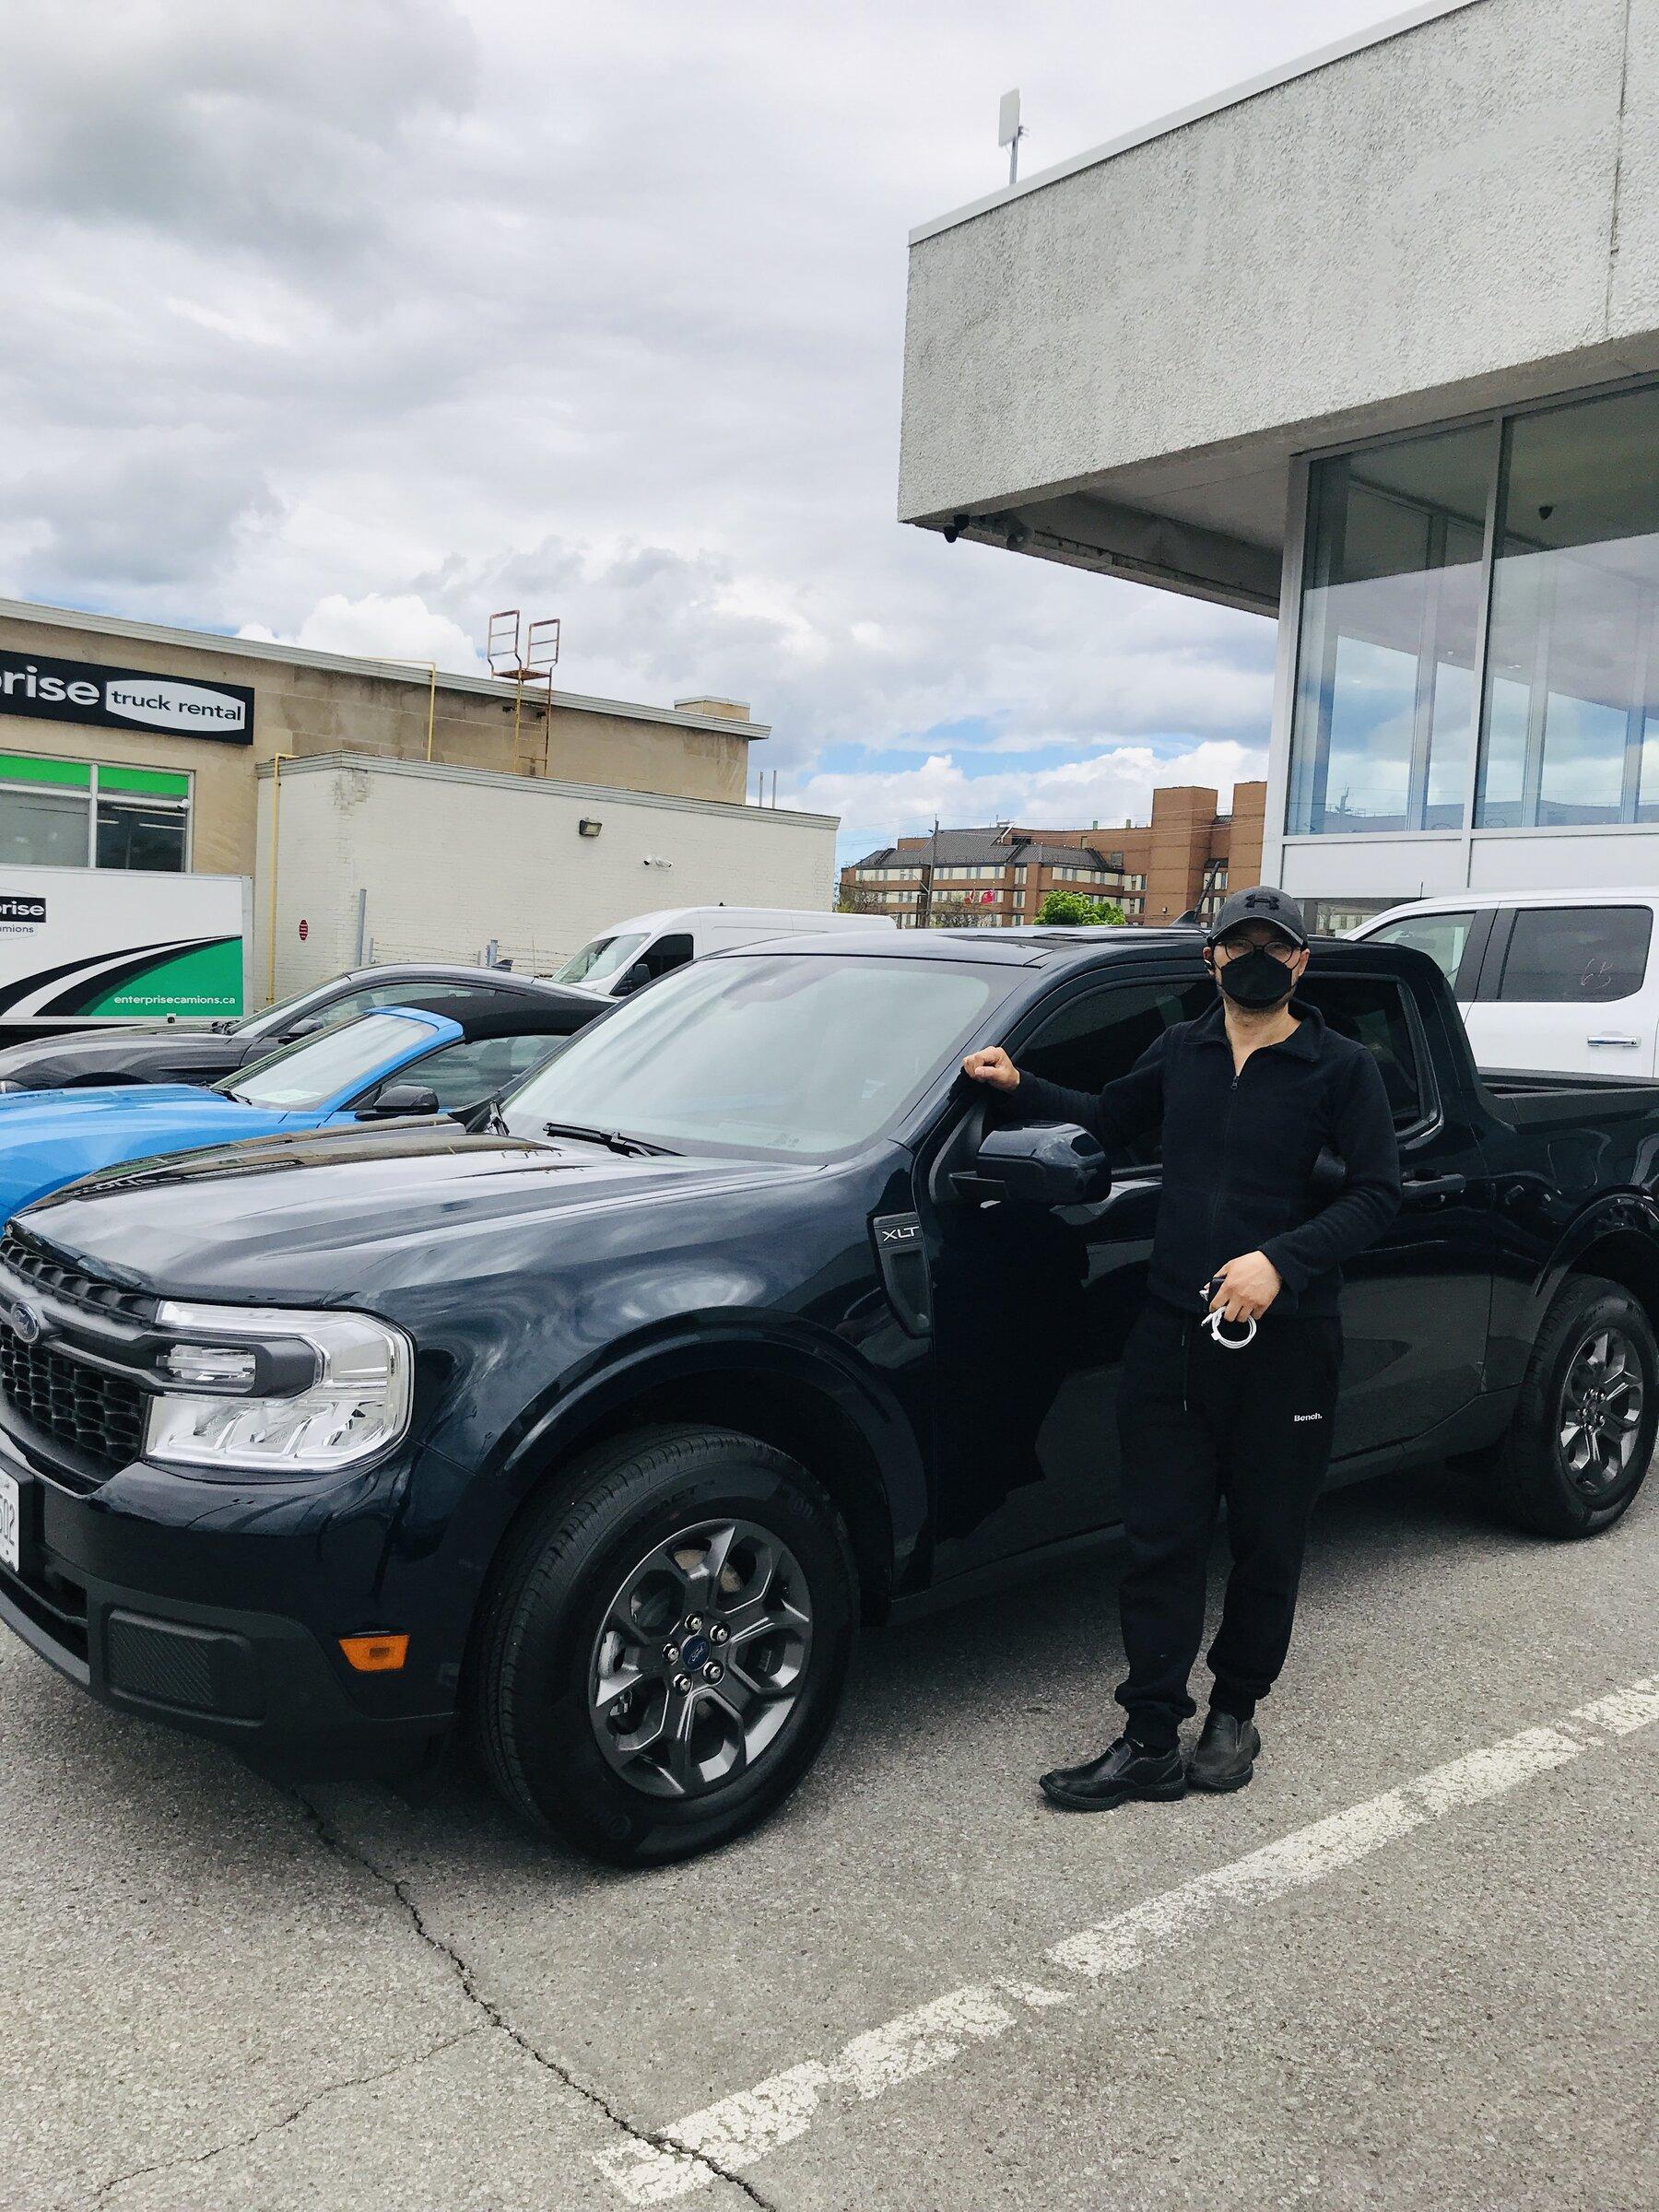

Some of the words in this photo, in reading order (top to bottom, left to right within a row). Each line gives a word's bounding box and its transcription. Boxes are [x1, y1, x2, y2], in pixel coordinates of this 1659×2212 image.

[0, 665, 100, 705] rise
[112, 690, 171, 711] truck
[179, 701, 241, 721] rental
[0, 900, 45, 916] rise
[0, 924, 34, 934] mions
[113, 994, 236, 1006] enterprisecamions.ca
[881, 1225, 920, 1241] XLT
